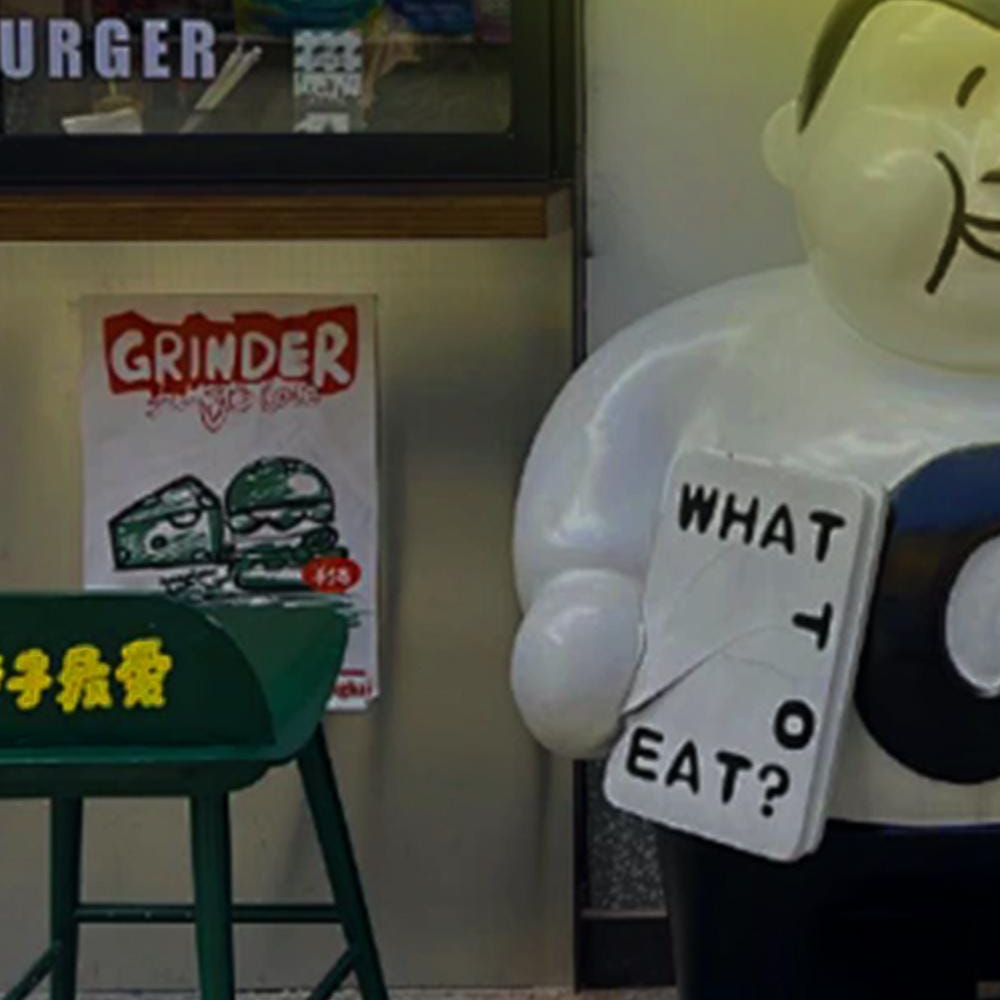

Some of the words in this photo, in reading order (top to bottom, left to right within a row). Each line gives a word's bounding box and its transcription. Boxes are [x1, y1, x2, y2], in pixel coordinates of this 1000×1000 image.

[0, 19, 216, 79] URGER
[111, 322, 351, 386] GRINDER
[679, 483, 846, 563] WHAT
[0, 637, 172, 712] 子最爱
[625, 726, 791, 818] EAT?
